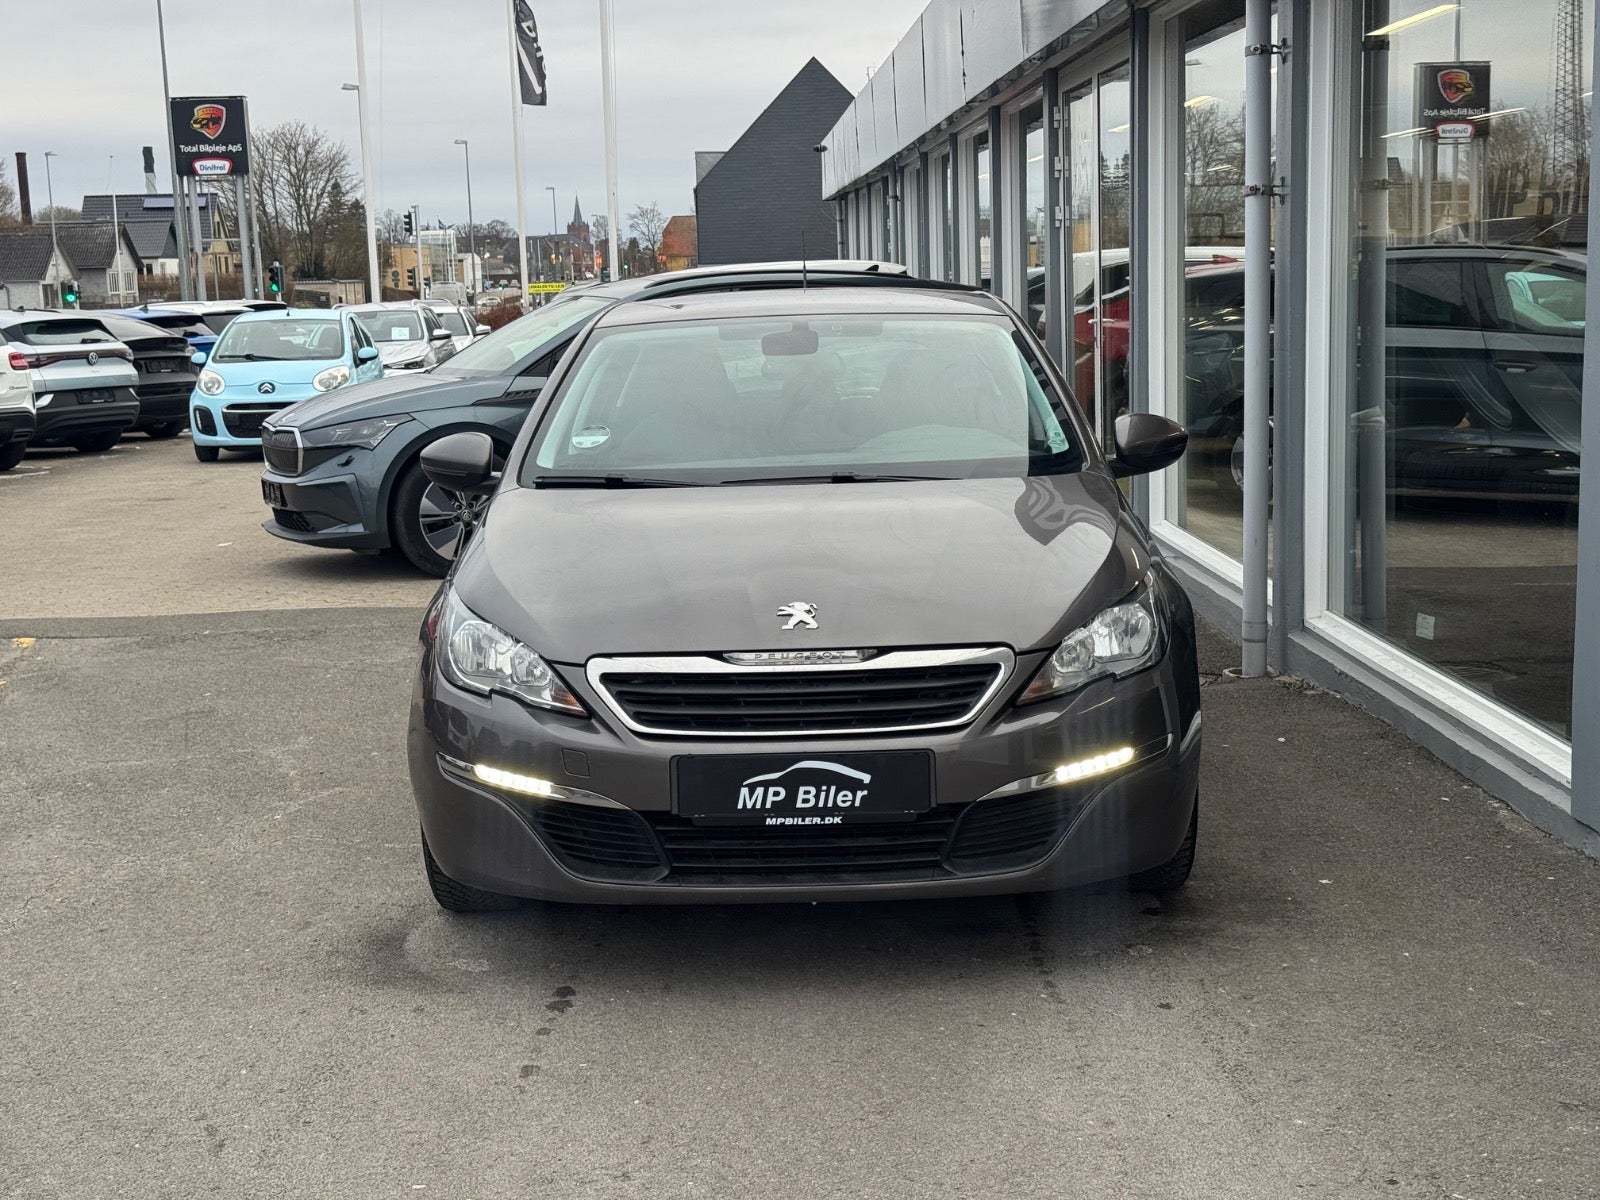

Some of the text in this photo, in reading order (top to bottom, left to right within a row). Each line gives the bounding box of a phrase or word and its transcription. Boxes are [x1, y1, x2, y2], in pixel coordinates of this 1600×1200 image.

[199, 144, 226, 153] Bilpleje
[228, 144, 242, 153] ApS
[199, 164, 226, 172] Dinitrol
[754, 651, 846, 661] PEUGEOT
[737, 785, 869, 810] MP Biler
[765, 816, 843, 826] MPBILER.DK
